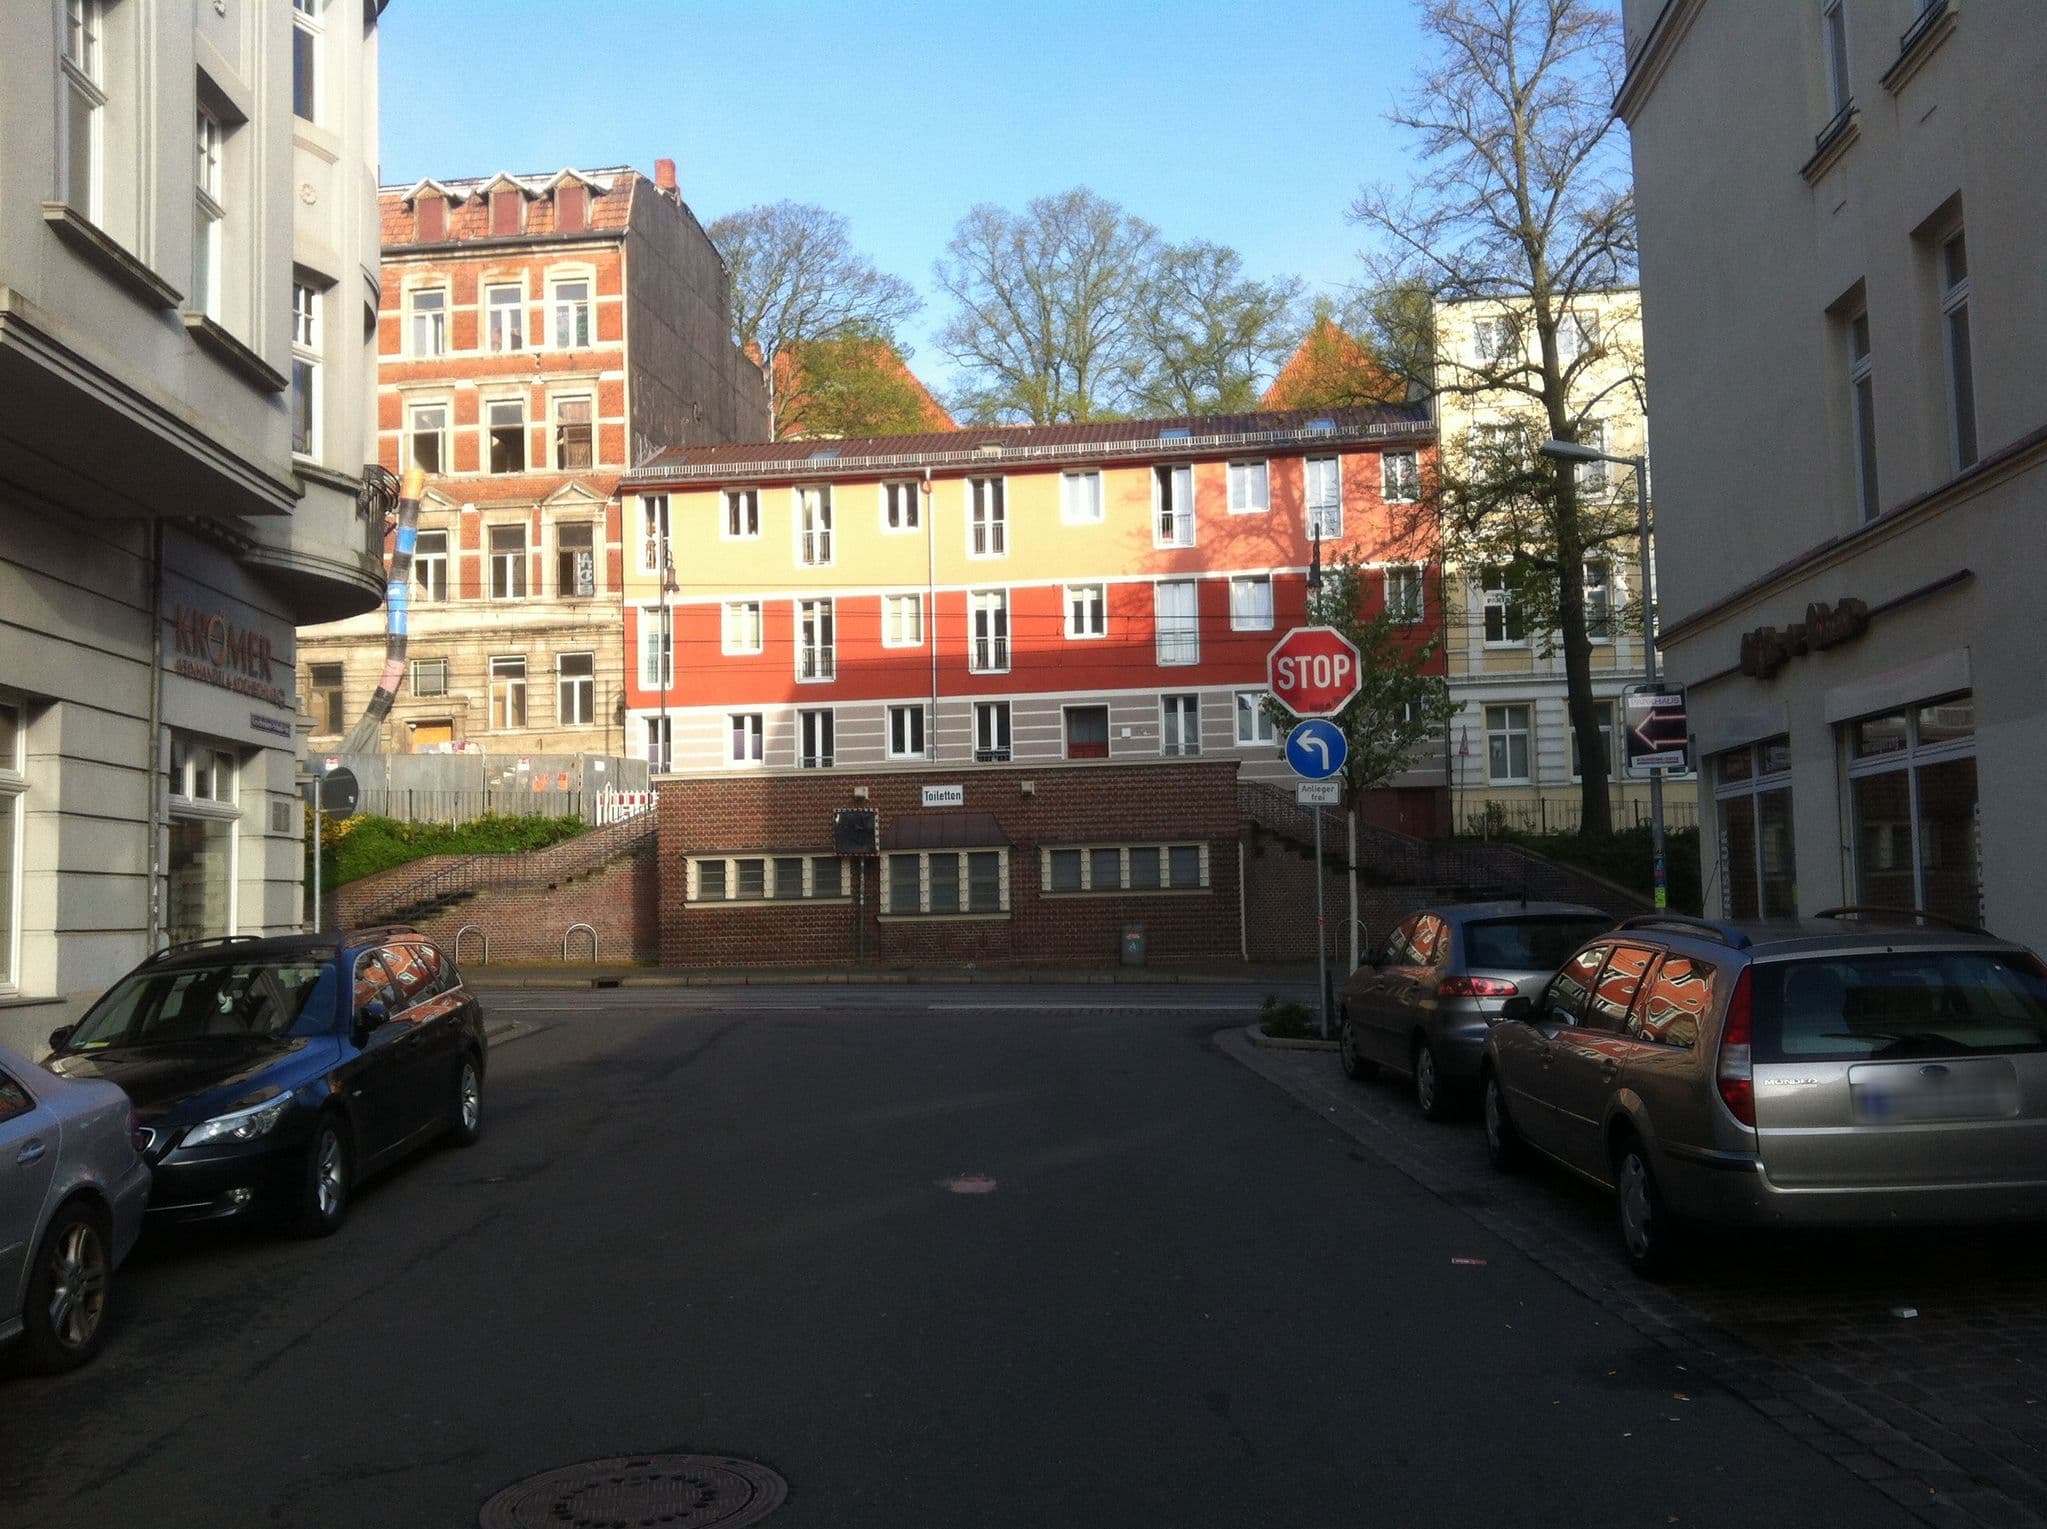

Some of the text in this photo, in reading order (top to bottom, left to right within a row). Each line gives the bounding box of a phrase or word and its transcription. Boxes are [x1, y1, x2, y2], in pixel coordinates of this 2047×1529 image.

[1278, 654, 1350, 690] STOP
[1631, 696, 1680, 706] PARKHAUS
[1302, 785, 1335, 793] Anlieger
[924, 790, 961, 801] Toiletten
[1311, 793, 1325, 801] frei
